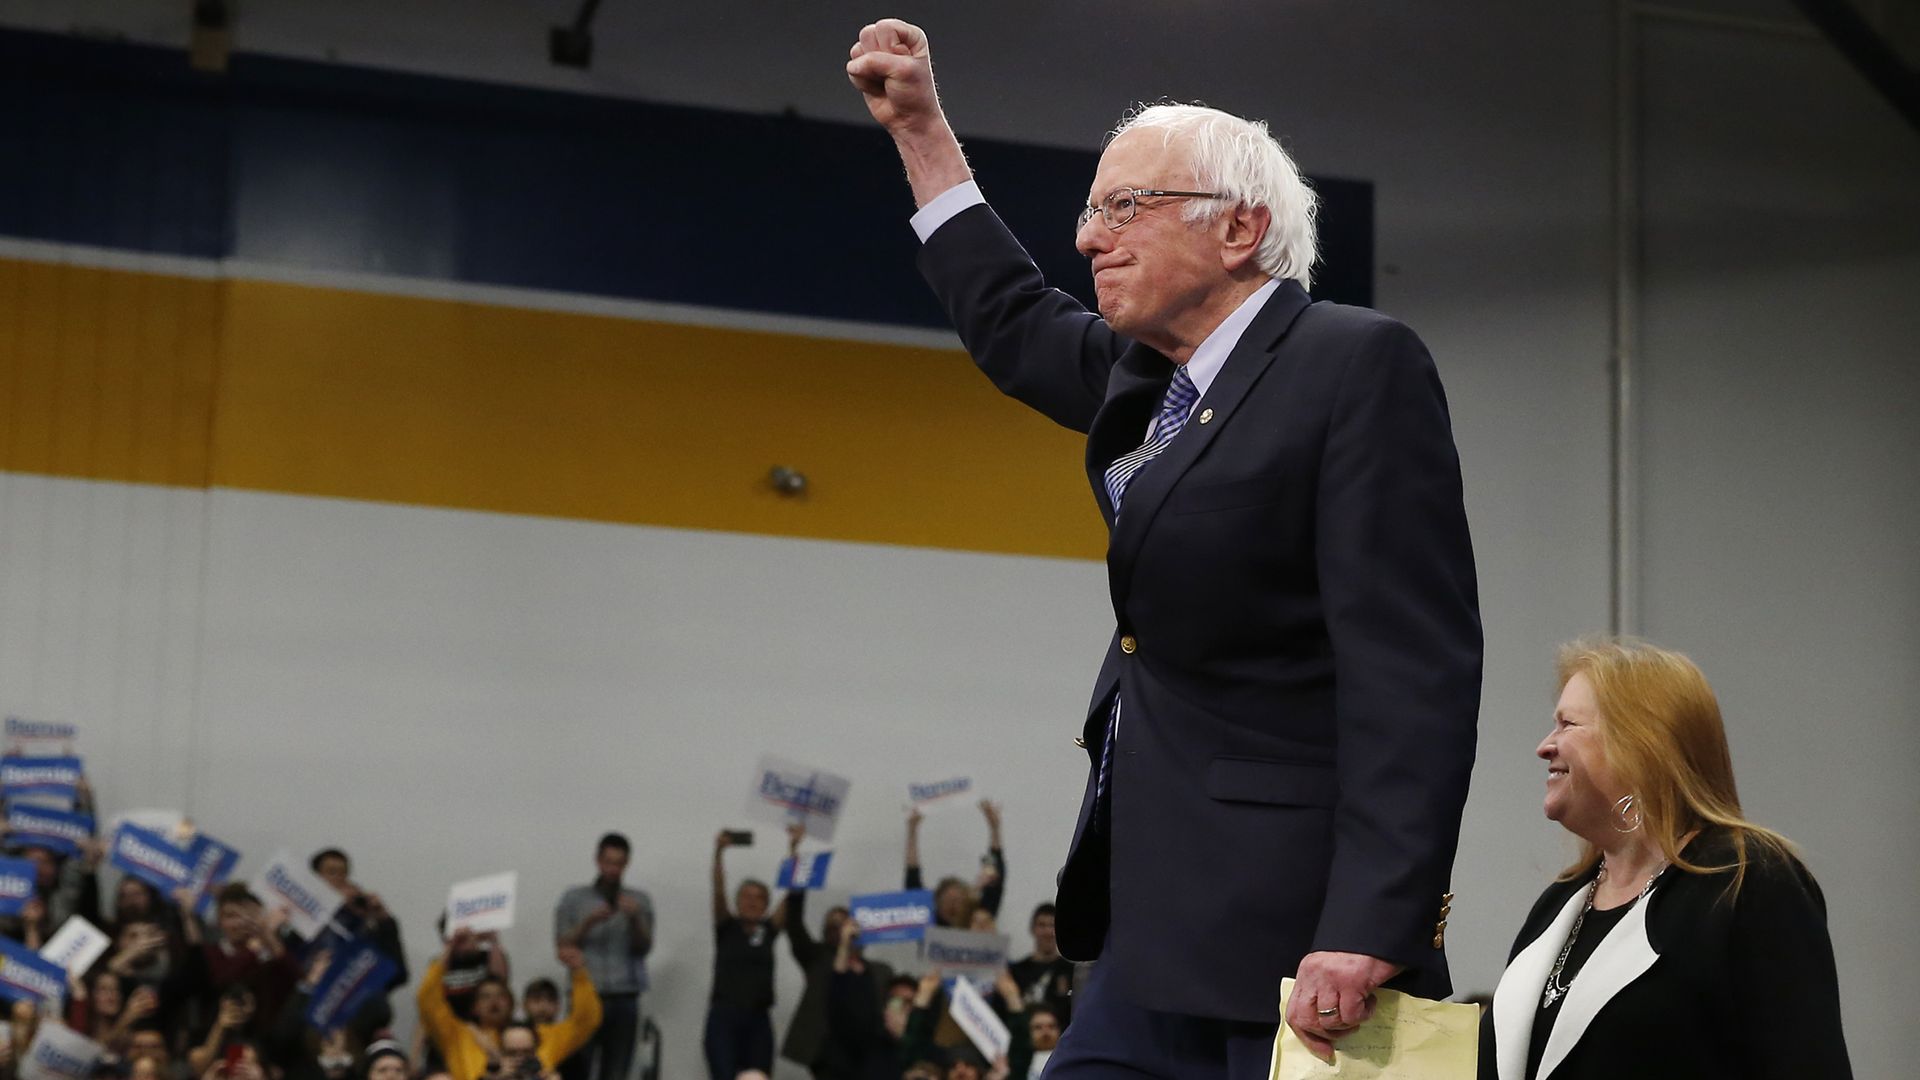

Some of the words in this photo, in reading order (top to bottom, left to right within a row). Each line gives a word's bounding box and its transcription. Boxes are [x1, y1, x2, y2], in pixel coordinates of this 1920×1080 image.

[1, 766, 76, 785] Bernie
[119, 834, 190, 881] Bernie
[855, 904, 930, 928] Bernie
[929, 943, 1003, 963] Bernie
